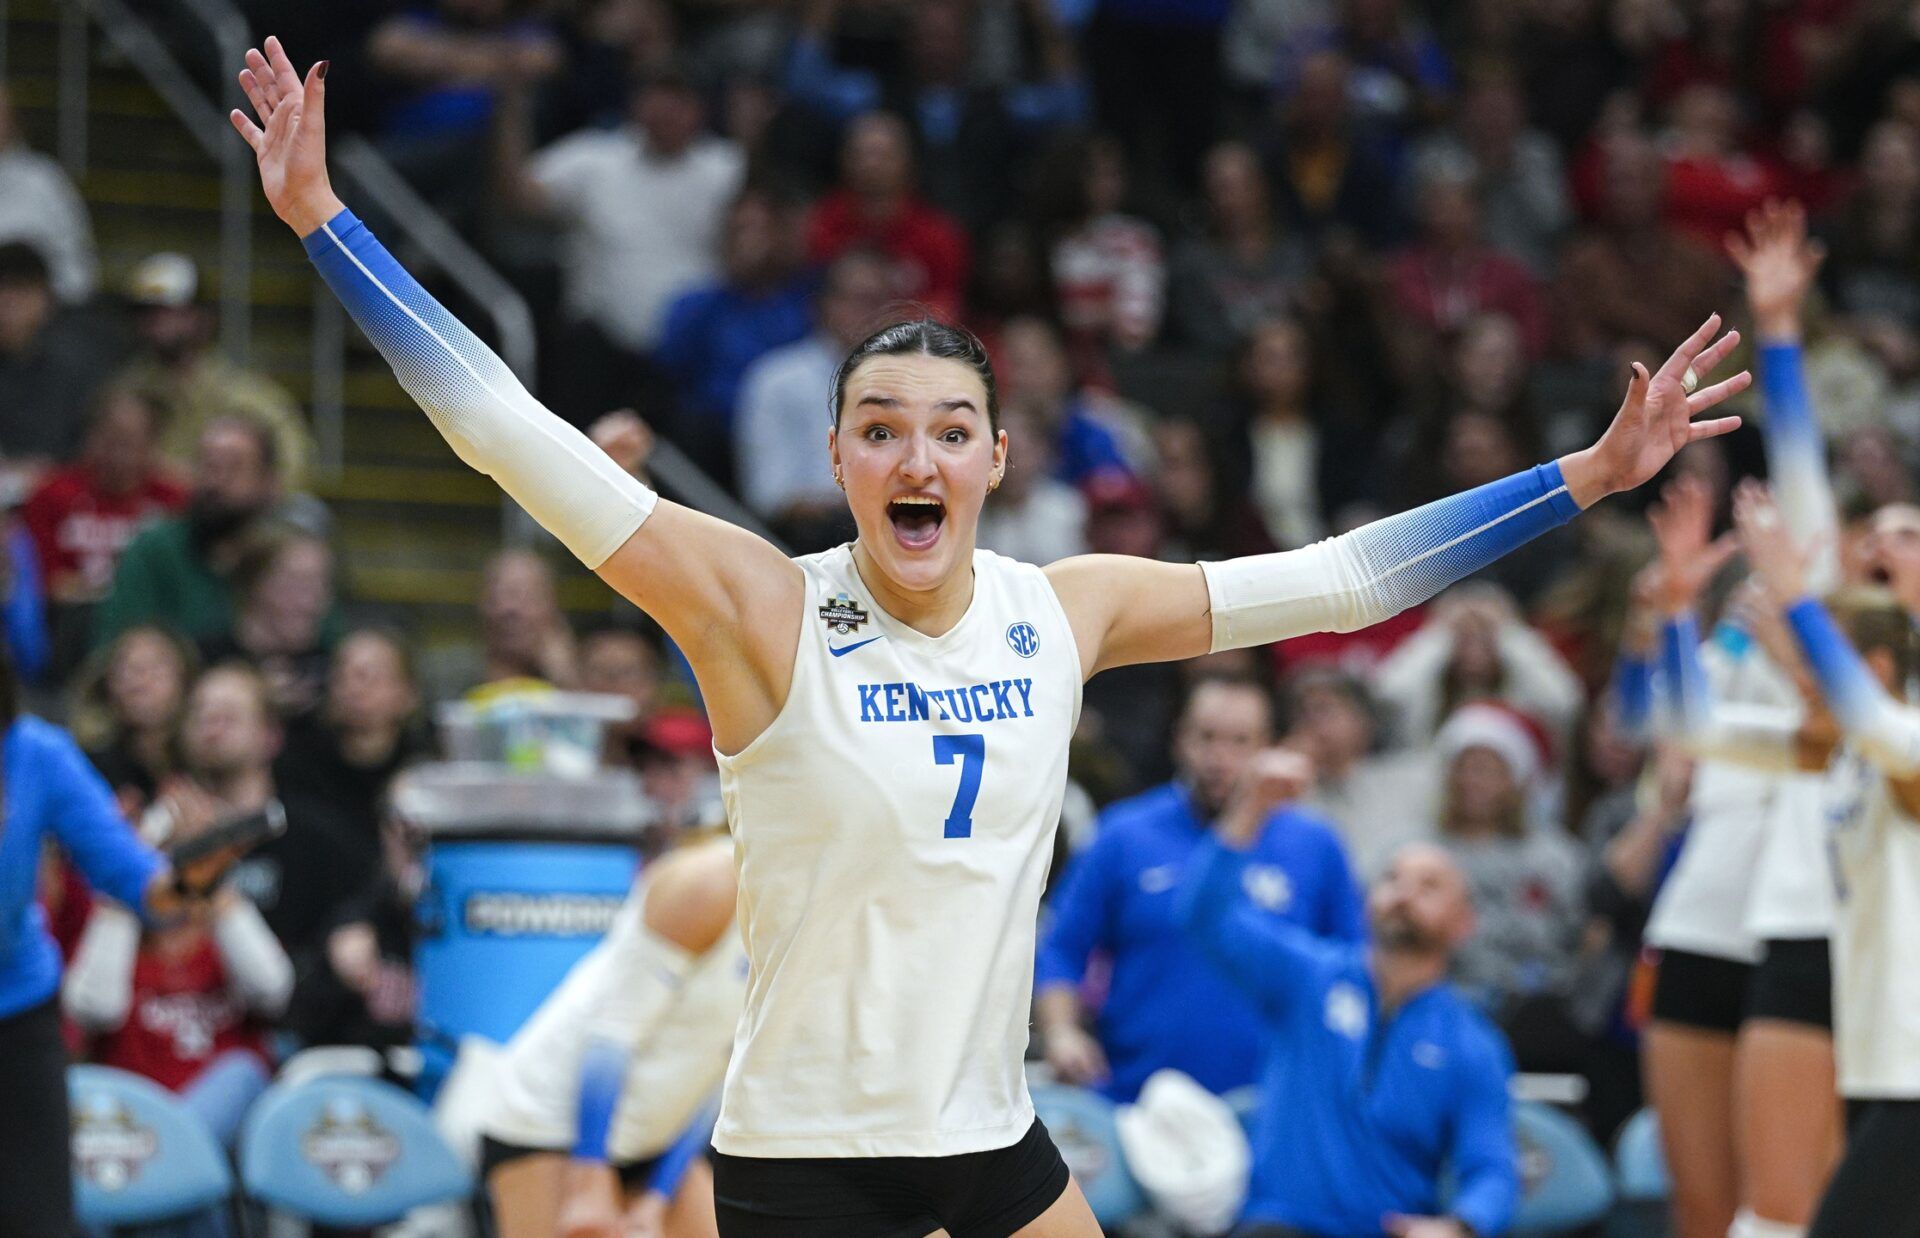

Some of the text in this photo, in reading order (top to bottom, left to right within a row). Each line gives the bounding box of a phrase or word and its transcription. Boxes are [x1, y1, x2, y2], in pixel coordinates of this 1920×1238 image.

[820, 610, 865, 621] CHAMPIONSHIP
[1009, 624, 1037, 656] SEC
[857, 678, 1034, 723] KENTUCKY
[932, 734, 986, 838] 7
